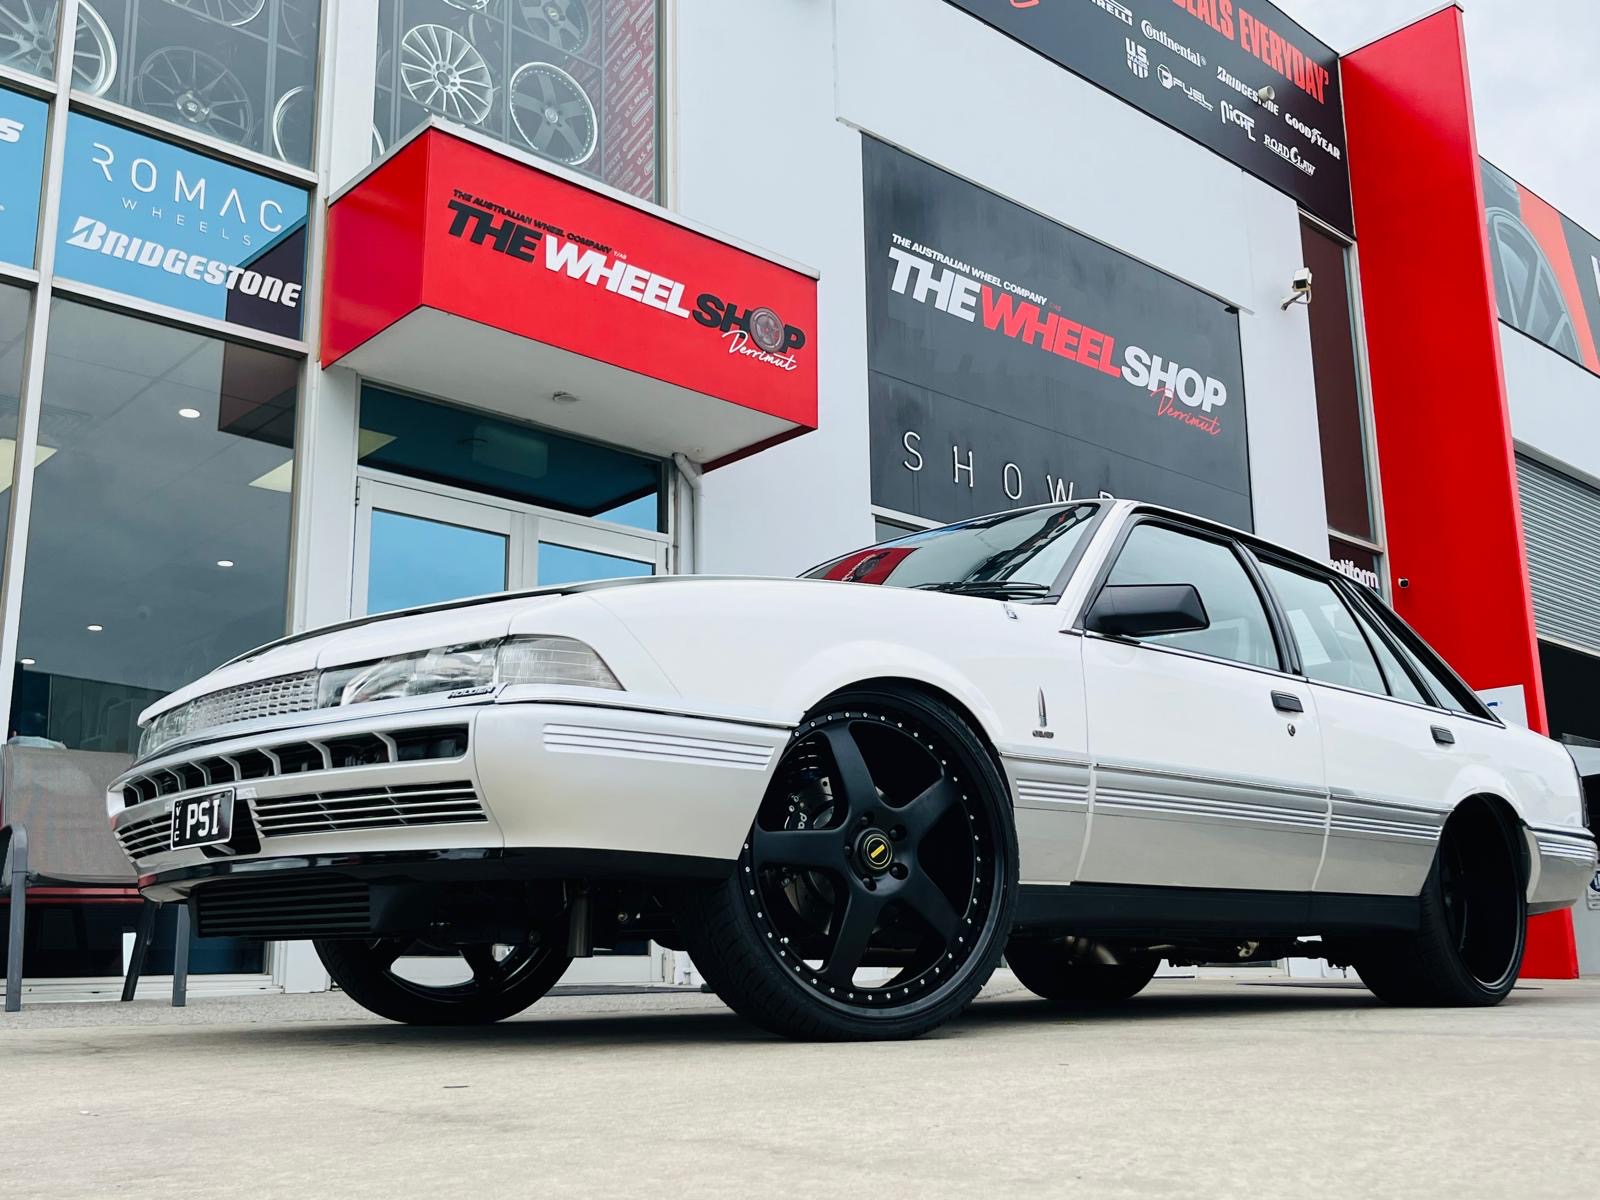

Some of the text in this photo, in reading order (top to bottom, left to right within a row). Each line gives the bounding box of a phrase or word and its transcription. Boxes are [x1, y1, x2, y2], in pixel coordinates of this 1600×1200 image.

[1090, 0, 1133, 26] RELLI
[1172, 0, 1235, 41] ALS
[1141, 19, 1201, 68] Continental
[1216, 66, 1279, 116] BRIDGESONE
[1285, 112, 1341, 160] GOODYEAR
[92, 142, 283, 233] ROMAC
[121, 197, 252, 247] WHEELS
[453, 189, 473, 202] THE
[473, 194, 532, 225] AUSTRALIAN
[534, 219, 565, 238] WHEEL
[567, 233, 612, 254] COMPANY
[65, 215, 302, 308] BRIDGESTONE
[448, 199, 806, 354] THE WHEEL SHOP
[892, 233, 1048, 306] THE AUSTRALIAN WHEEL COMPANY
[721, 330, 798, 371] Derrimut
[888, 247, 1227, 413] THE WHEEL SHOP
[1150, 387, 1222, 436] Derrimut
[902, 431, 1115, 503] SHOW
